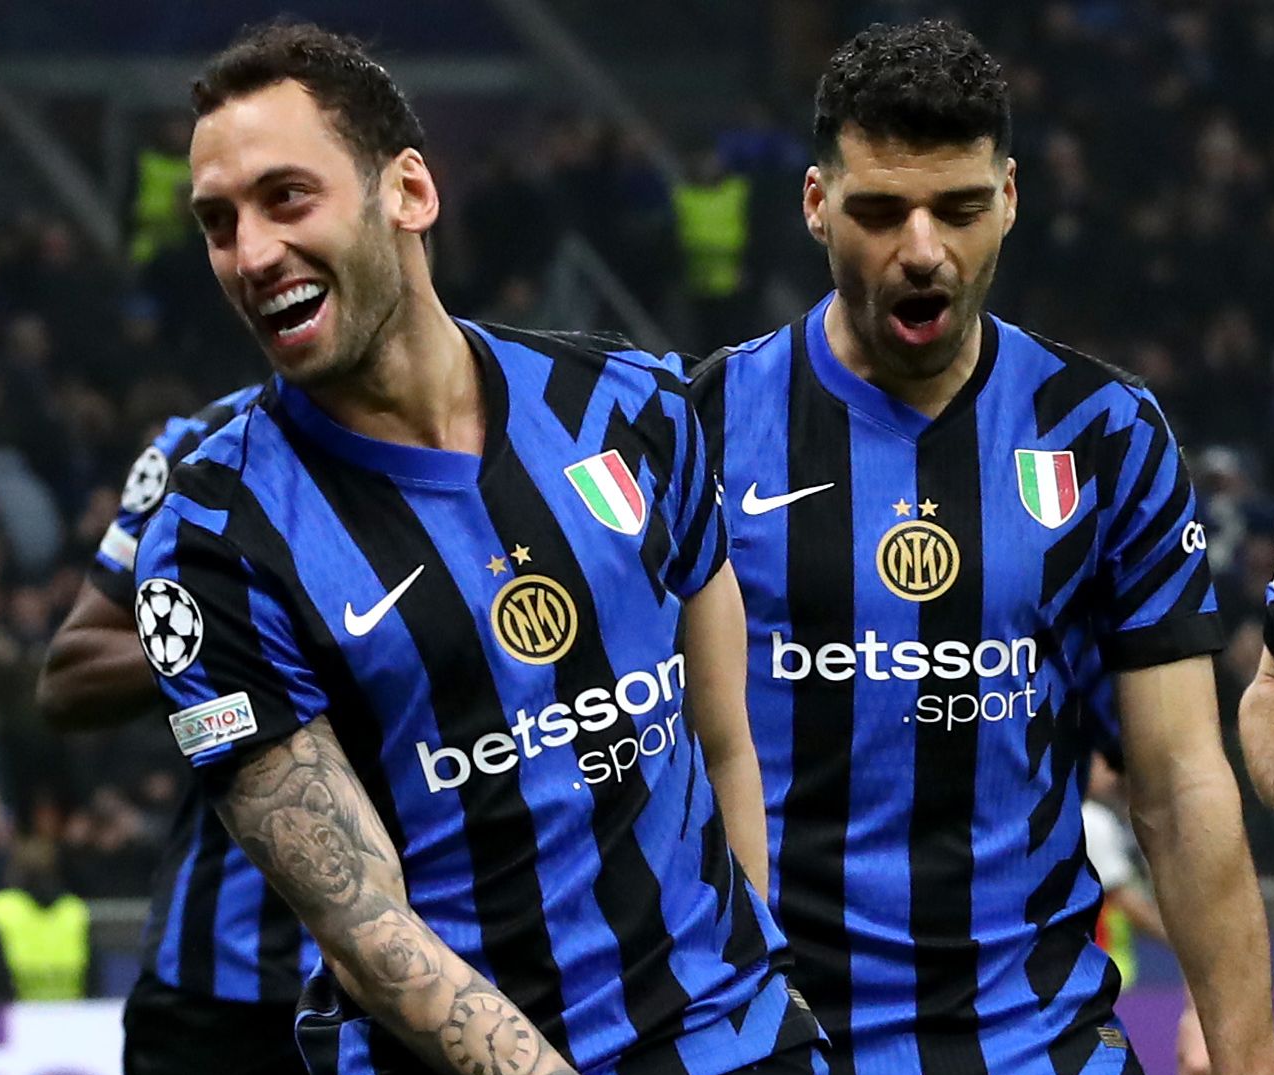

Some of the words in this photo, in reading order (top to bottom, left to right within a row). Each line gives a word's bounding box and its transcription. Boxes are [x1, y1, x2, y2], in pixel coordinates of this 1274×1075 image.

[771, 630, 1038, 681] betsson
[415, 653, 686, 793] betsson
[902, 682, 1037, 731] .sport
[572, 709, 683, 790] .spor
